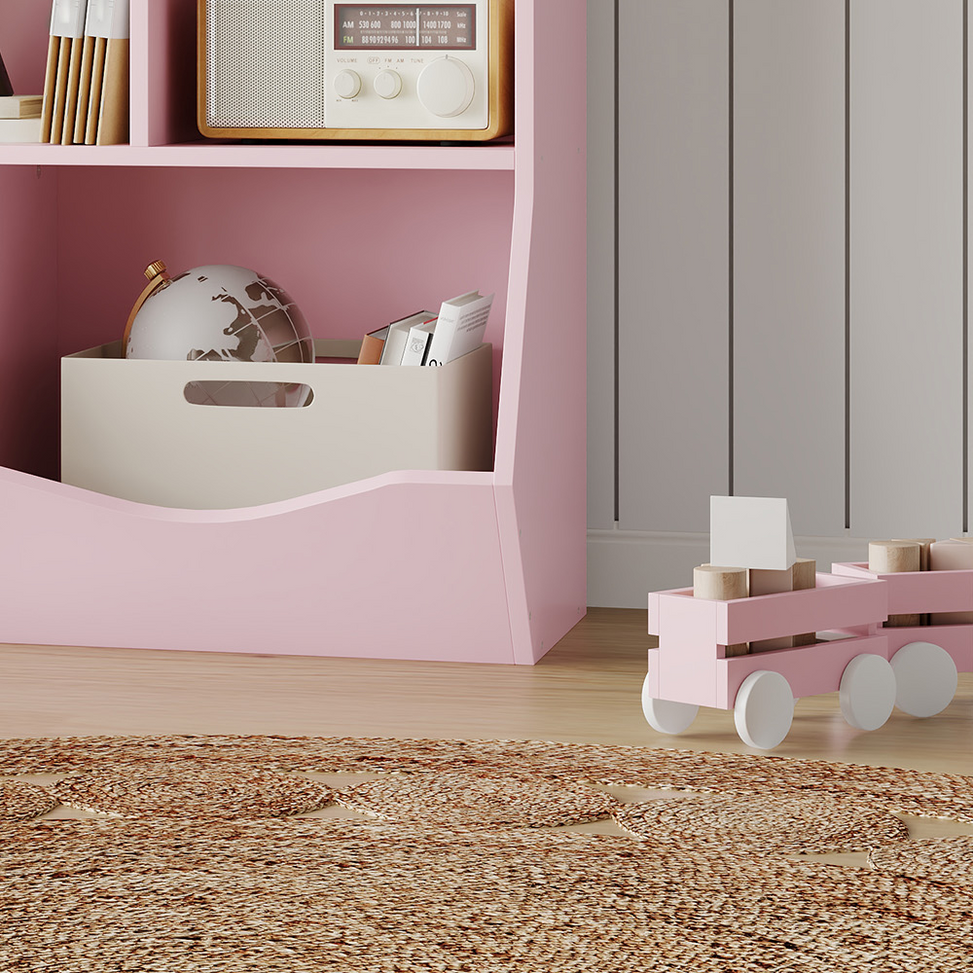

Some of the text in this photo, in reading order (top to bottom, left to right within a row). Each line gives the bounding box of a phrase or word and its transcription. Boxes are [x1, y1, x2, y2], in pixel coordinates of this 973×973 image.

[342, 21, 355, 29] AM
[359, 21, 370, 29] 530
[370, 21, 381, 29] 600
[390, 21, 402, 29] 800
[403, 21, 416, 29] 1000
[423, 21, 437, 29] 1400
[437, 21, 452, 29] 1700
[343, 35, 354, 44] FM
[405, 35, 416, 44] 100
[421, 35, 432, 44] 104
